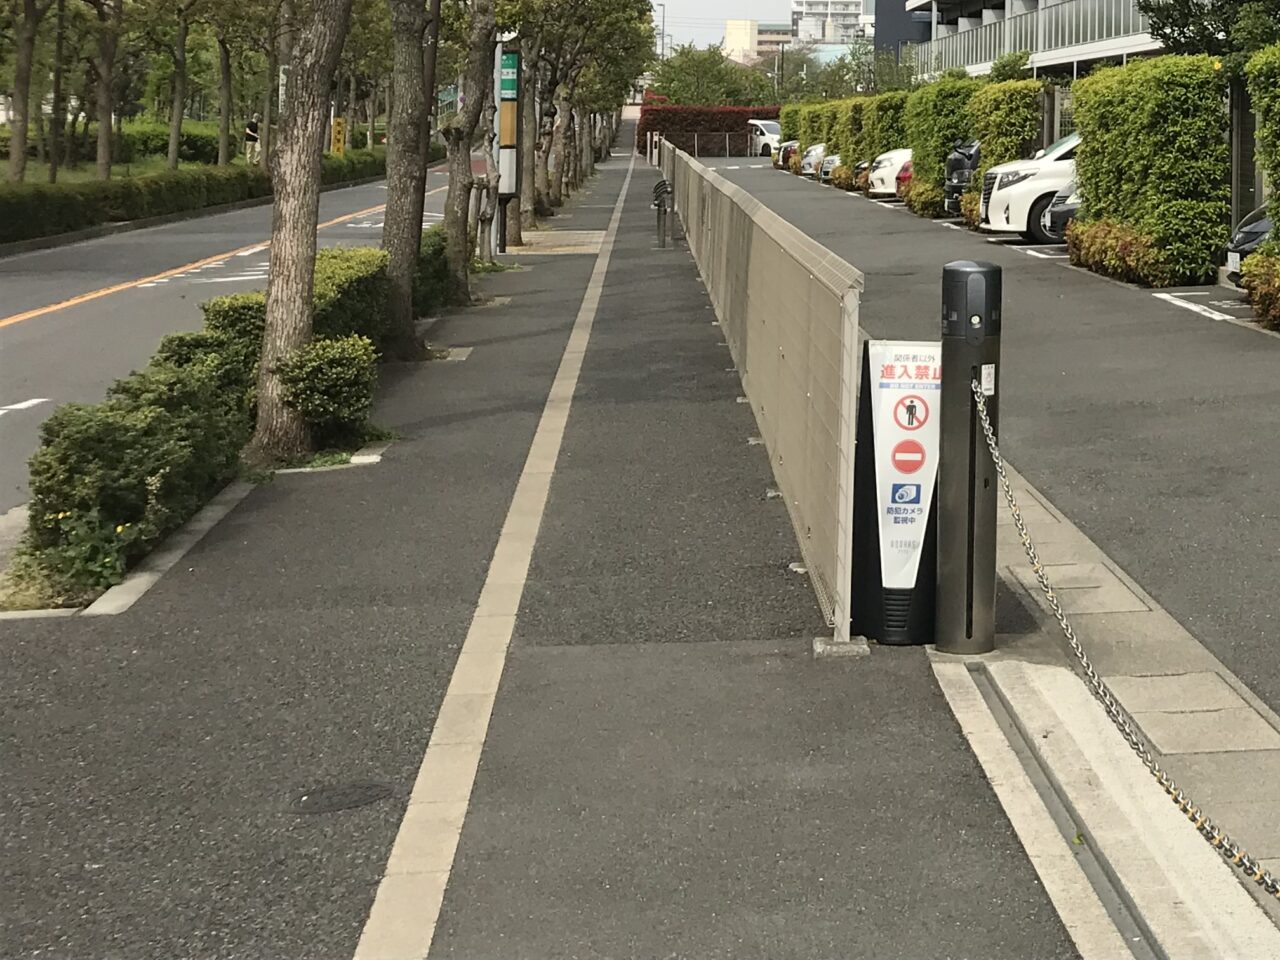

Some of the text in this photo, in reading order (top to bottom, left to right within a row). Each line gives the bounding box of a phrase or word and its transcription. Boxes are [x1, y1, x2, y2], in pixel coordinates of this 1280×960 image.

[880, 364, 943, 380] 進入禁止
[886, 506, 924, 515] 防犯カメラ
